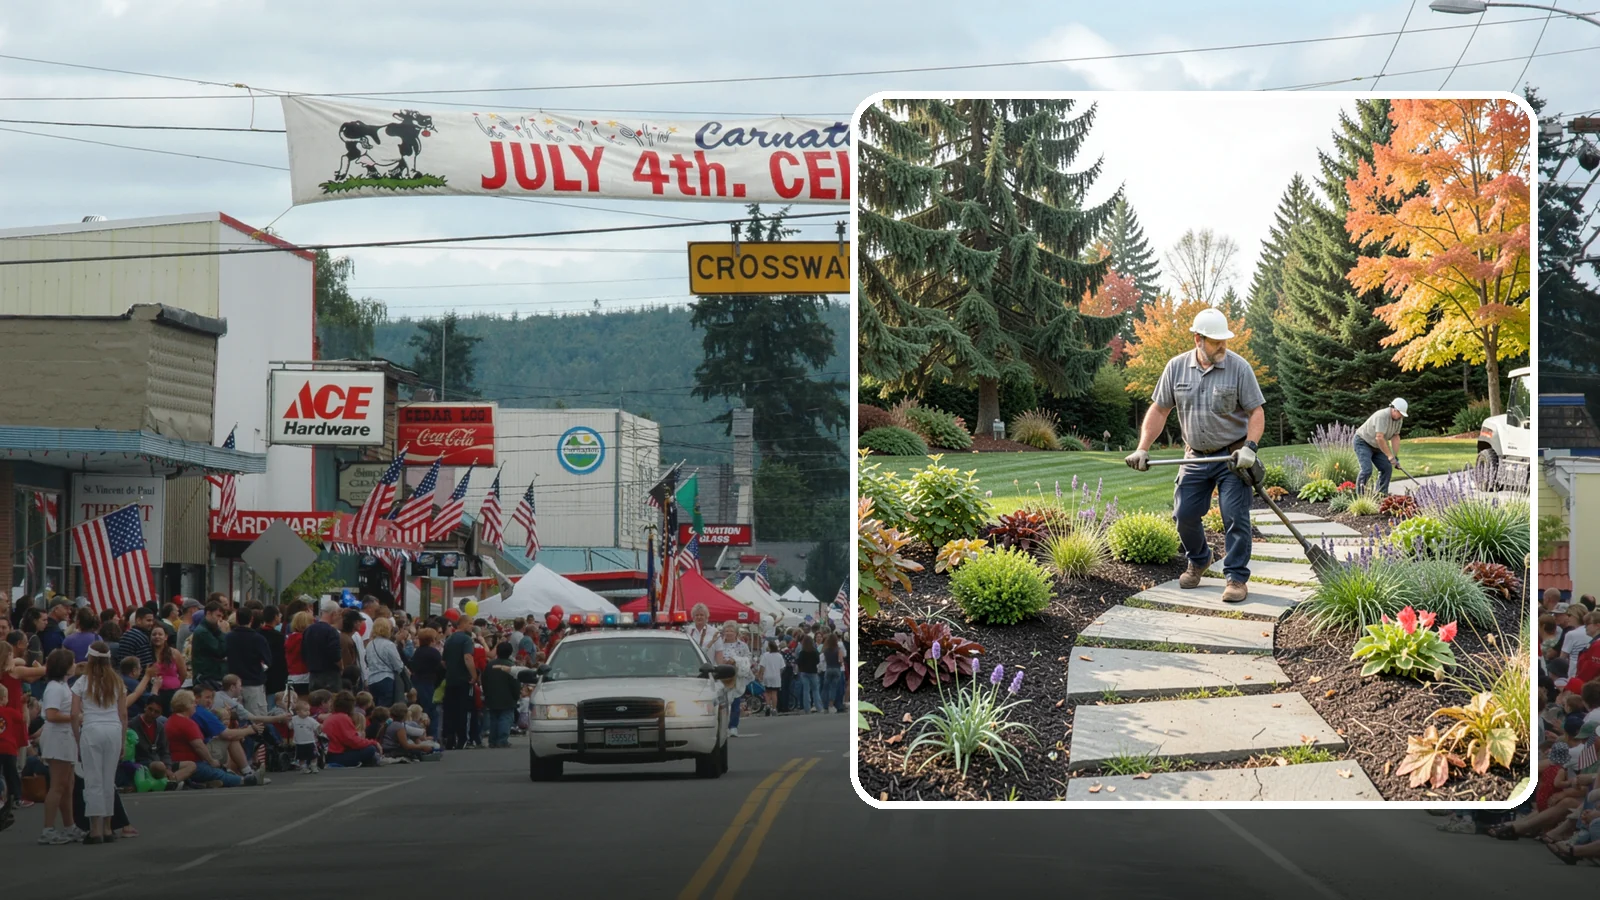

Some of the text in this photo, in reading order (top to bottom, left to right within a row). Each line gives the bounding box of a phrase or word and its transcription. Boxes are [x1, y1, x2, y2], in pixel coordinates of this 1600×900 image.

[695, 121, 850, 150] Carnat
[481, 140, 604, 192] JULY
[632, 150, 746, 198] 4th.
[697, 254, 850, 280] CROSSWA
[283, 379, 374, 420] ACE
[406, 409, 485, 422] CEDAR LOG
[283, 421, 371, 436] Hardware
[354, 467, 384, 479] Simpl
[95, 485, 124, 495] Vincent
[126, 486, 136, 495] de
[138, 485, 155, 495] Paul
[688, 526, 741, 535] CRNATION
[699, 535, 730, 544] GLASS
